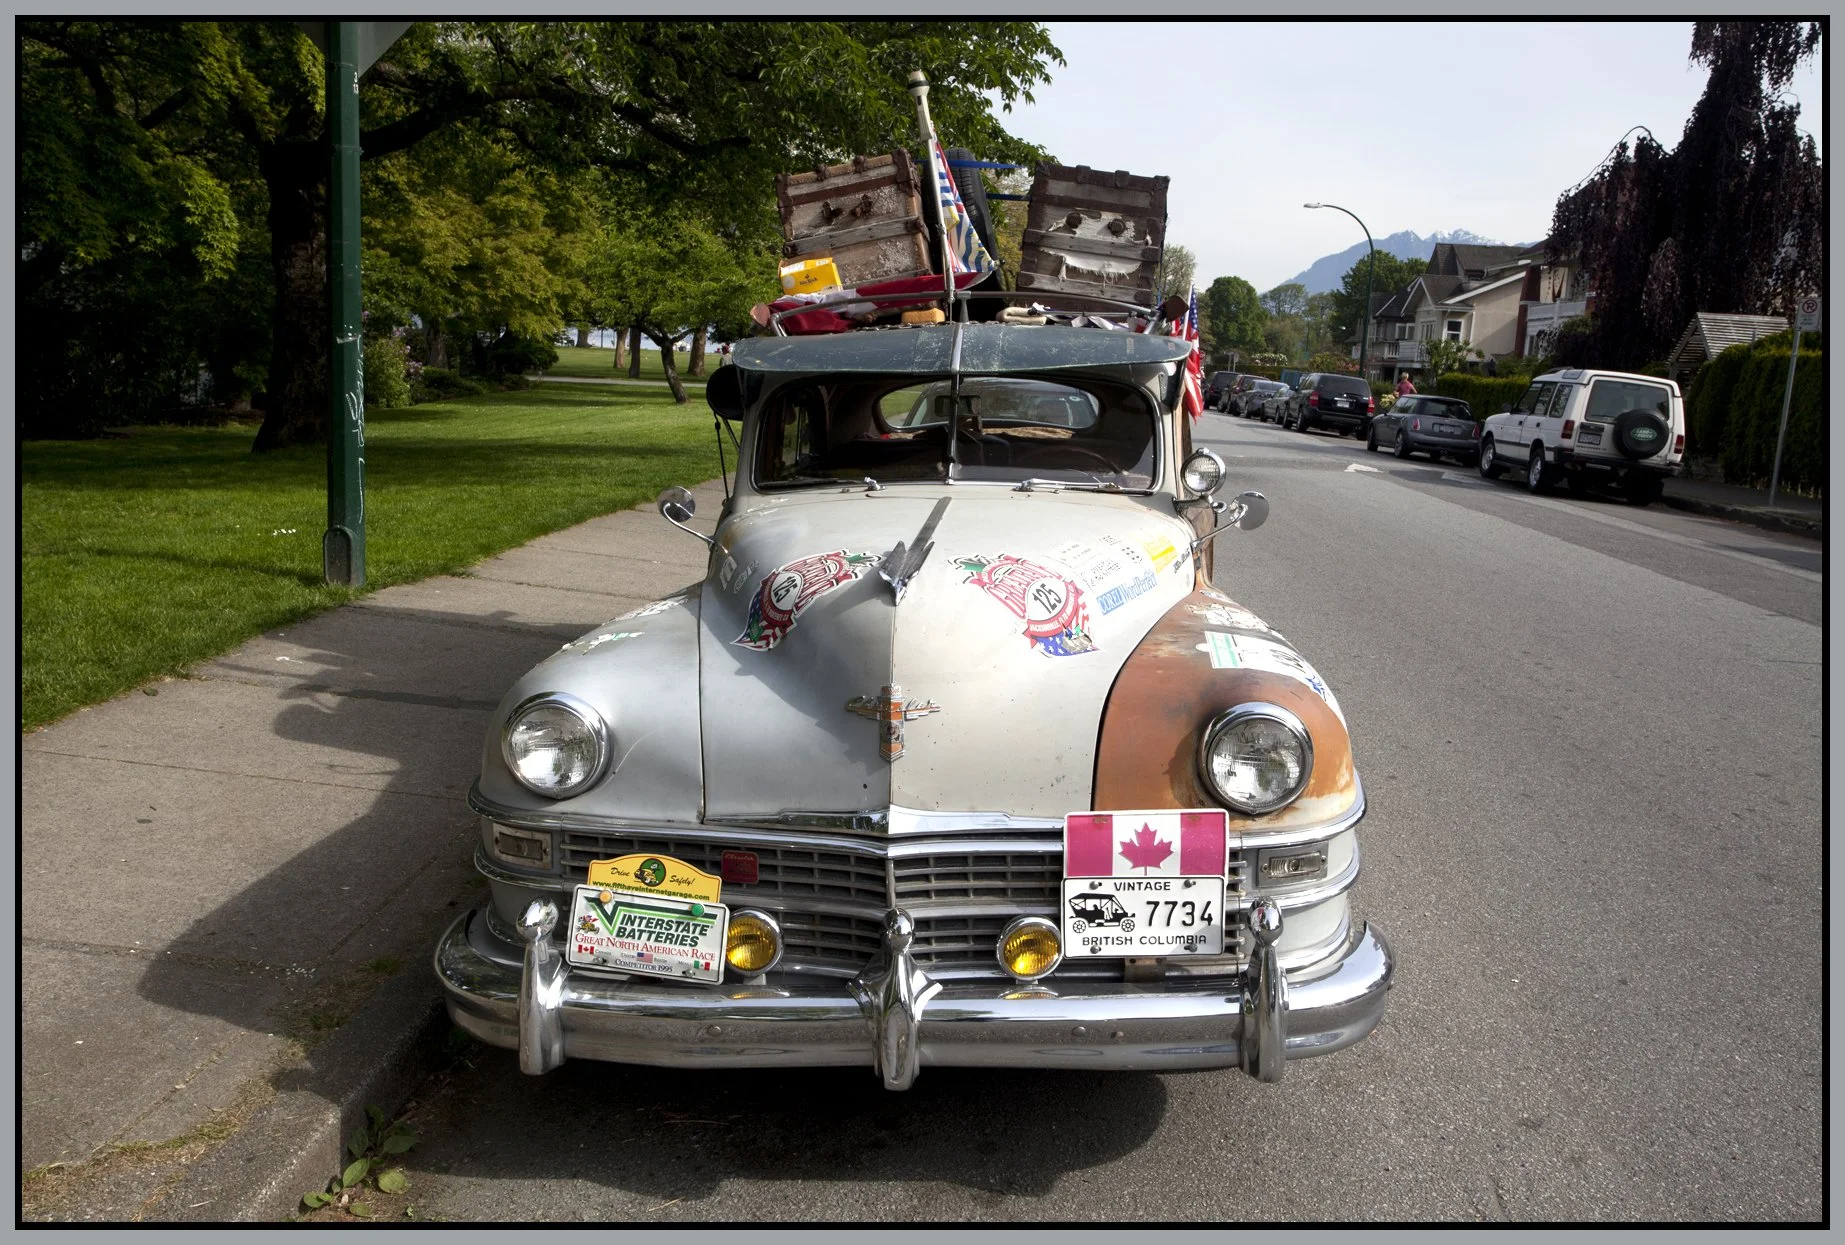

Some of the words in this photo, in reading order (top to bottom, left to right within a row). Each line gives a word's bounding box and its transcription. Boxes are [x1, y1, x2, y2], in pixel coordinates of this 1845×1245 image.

[773, 576, 798, 603] 125
[1032, 584, 1062, 614] 125
[1097, 588, 1124, 612] COREL
[611, 867, 630, 876] Drive
[670, 875, 695, 886] Safely!
[1114, 882, 1171, 891] VINTAGE
[592, 880, 710, 900] www.fifthaveinternetgarage.com
[1146, 900, 1214, 926] 7734
[620, 914, 710, 936] INTERSTATE
[576, 933, 605, 946] GREAT
[606, 936, 640, 950] NORTH
[642, 942, 689, 956] AMERICAN
[692, 948, 715, 960] RACE
[616, 926, 700, 948] BATTERIES
[1082, 936, 1132, 946] BRITISH
[1140, 935, 1207, 945] COLUMBIA
[658, 964, 673, 973] 1995
